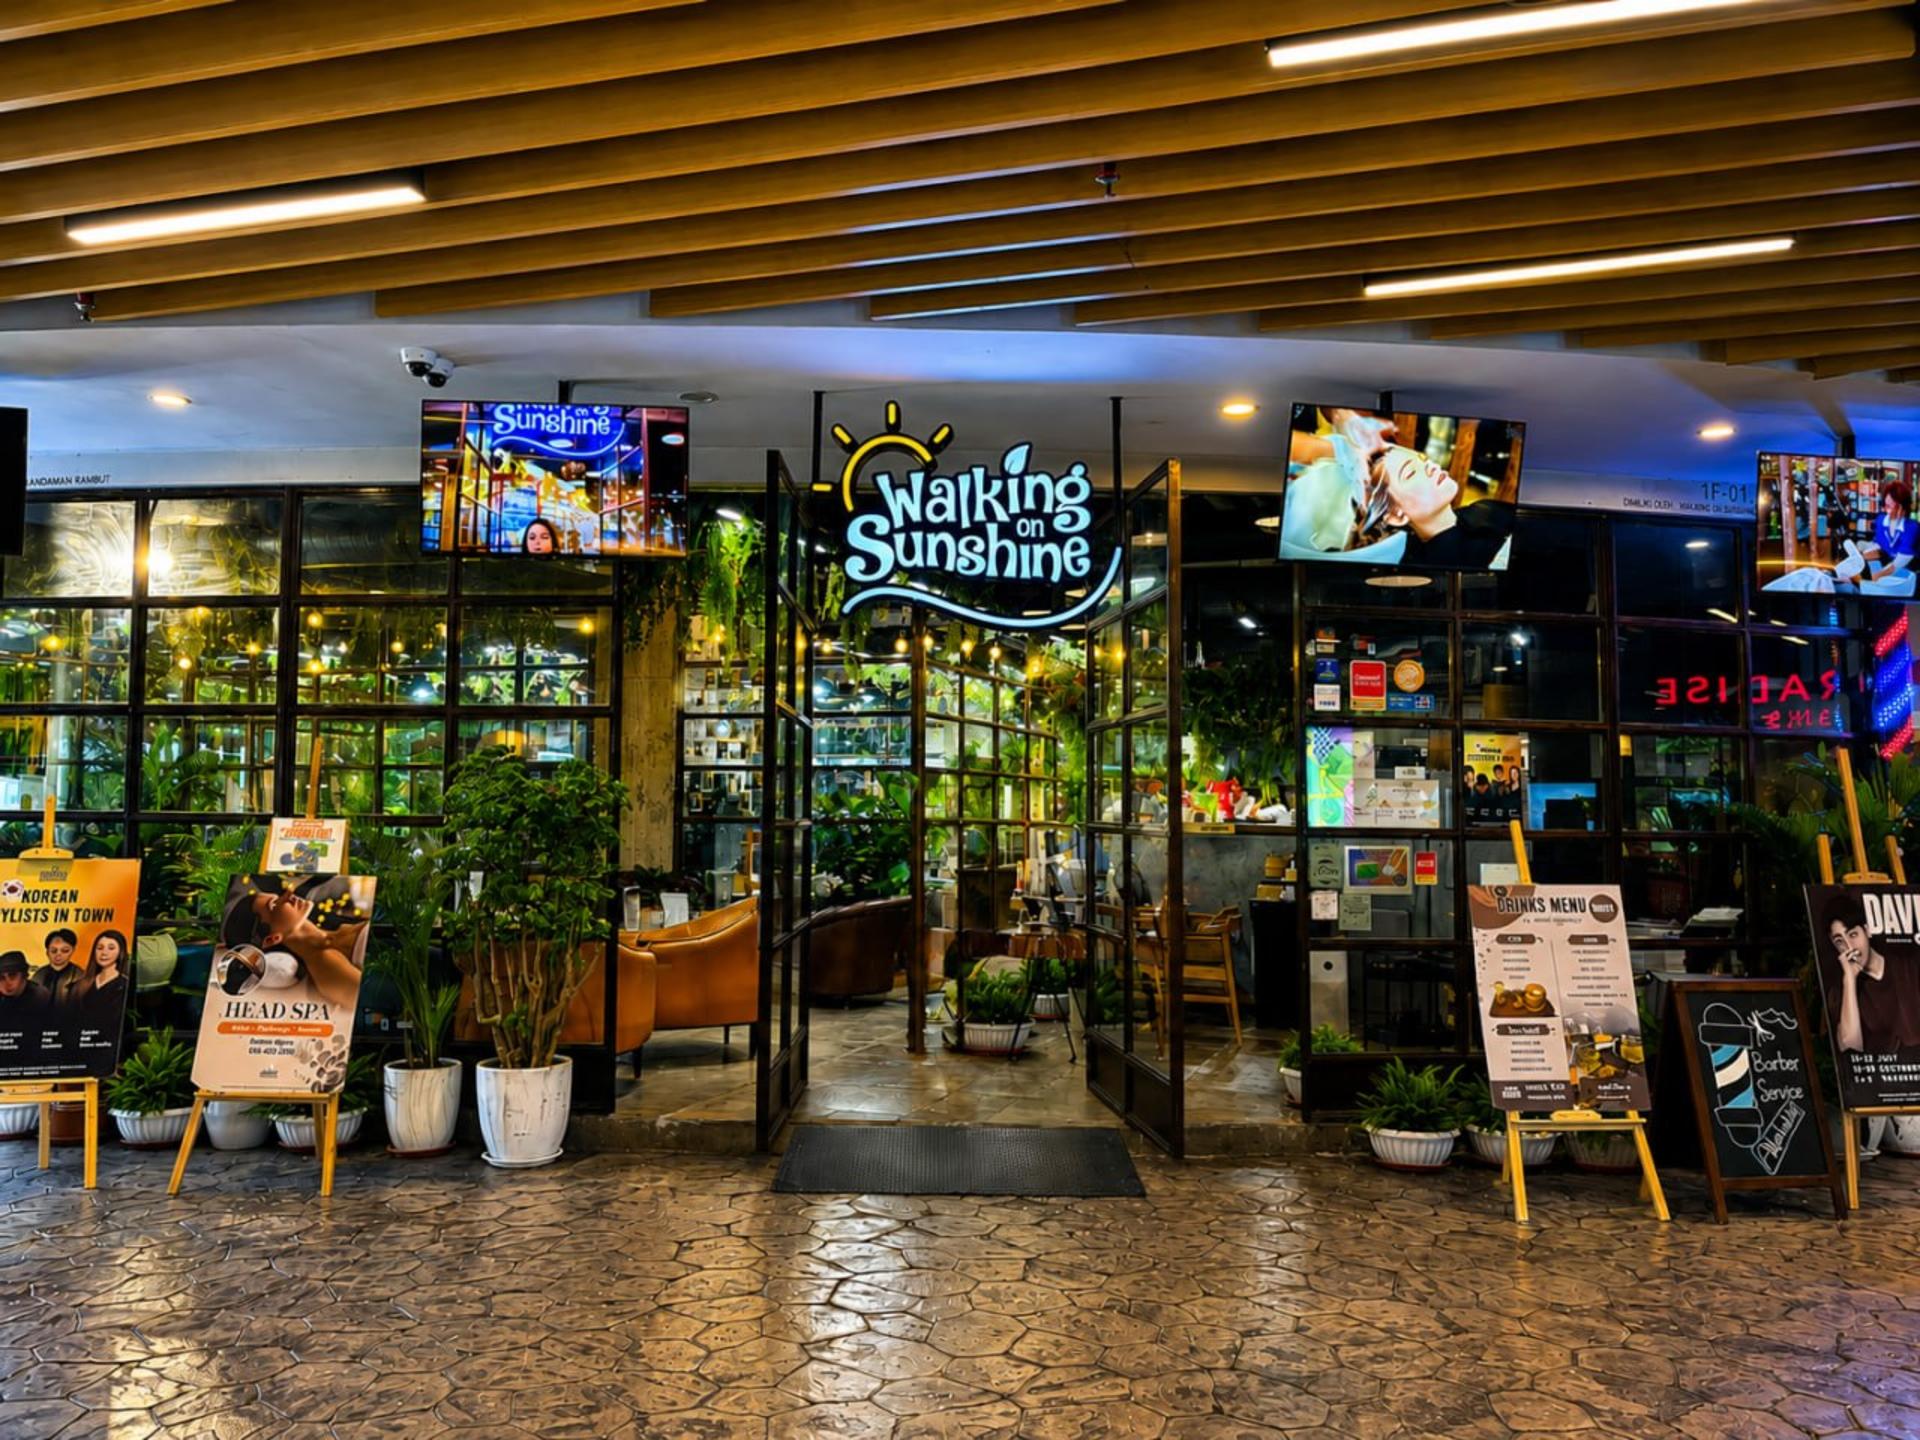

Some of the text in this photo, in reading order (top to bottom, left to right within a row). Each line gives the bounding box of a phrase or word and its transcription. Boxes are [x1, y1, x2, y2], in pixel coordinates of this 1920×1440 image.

[493, 404, 610, 435] Sunshine
[875, 446, 1091, 533] Walking
[1701, 481, 1747, 502] 1F-01
[1016, 517, 1045, 538] on
[844, 513, 1091, 582] Sunshine
[21, 889, 79, 904] KOREAN
[1497, 897, 1546, 914] DRINKS
[1550, 897, 1587, 914] MENU
[54, 908, 70, 923] IN
[74, 908, 115, 923] TOWN
[224, 1001, 330, 1021] HEAD SPA
[1751, 1051, 1800, 1073] Barber
[1756, 1078, 1804, 1103] Service
